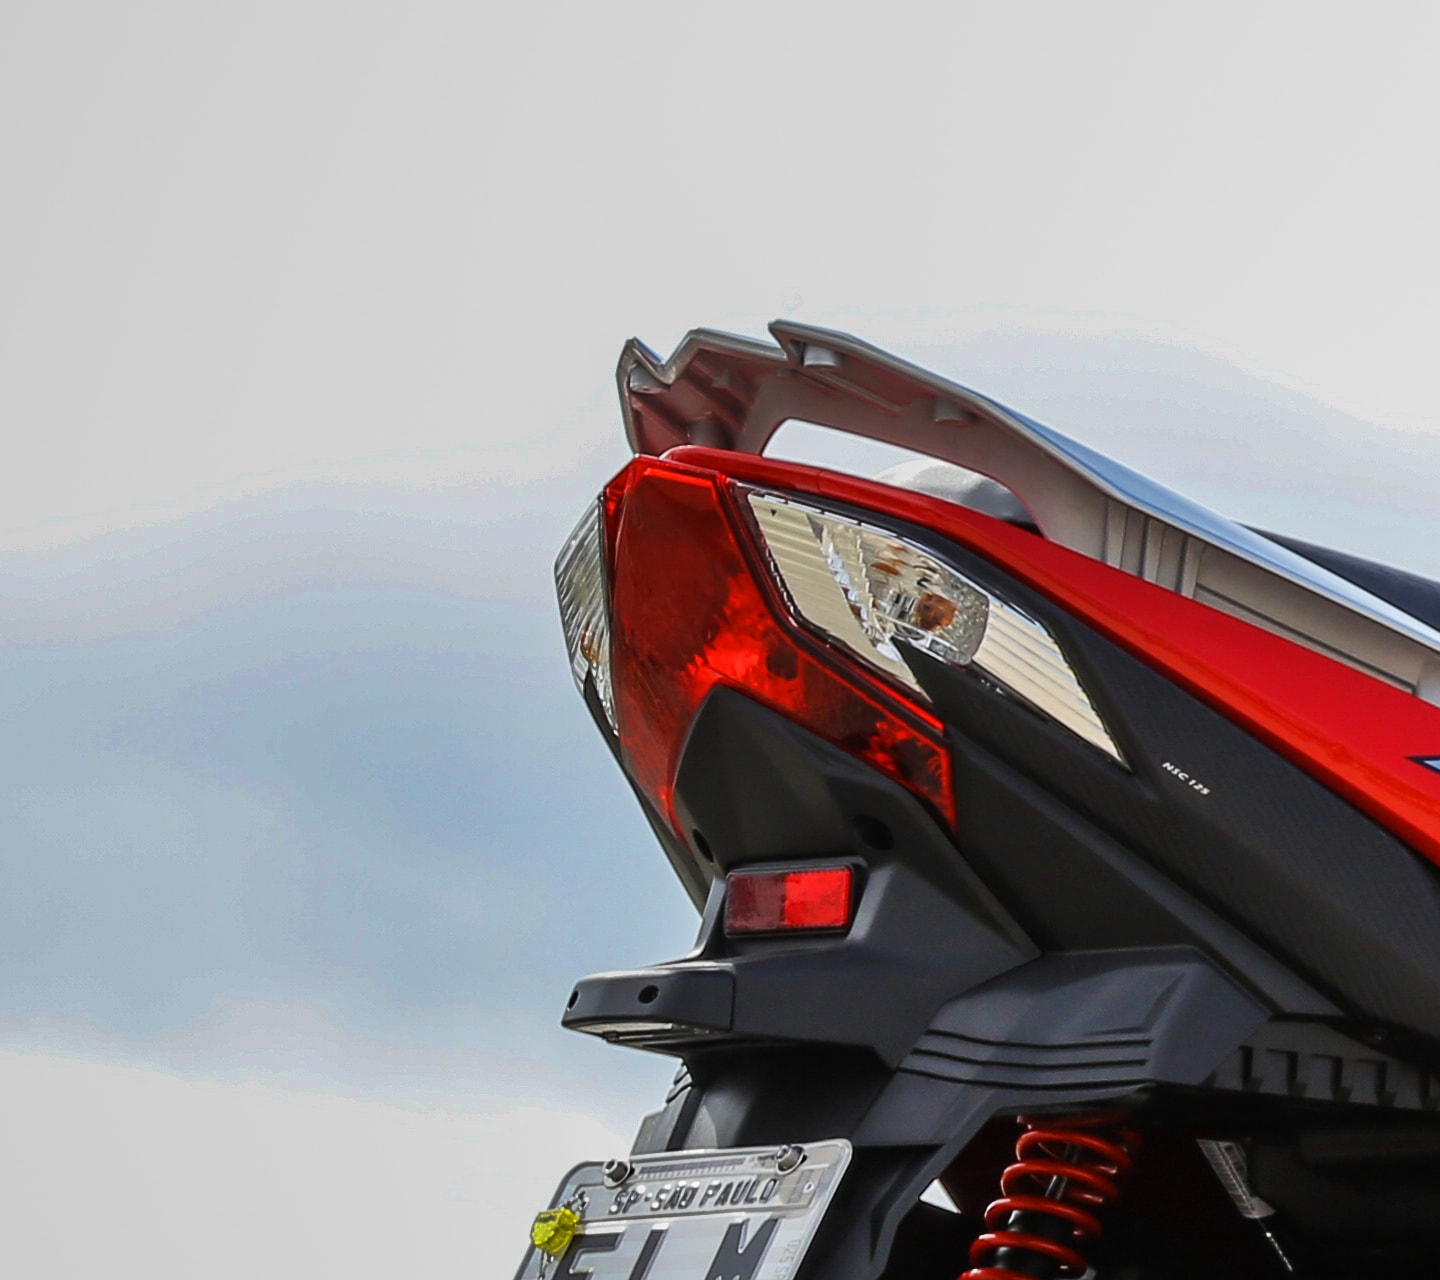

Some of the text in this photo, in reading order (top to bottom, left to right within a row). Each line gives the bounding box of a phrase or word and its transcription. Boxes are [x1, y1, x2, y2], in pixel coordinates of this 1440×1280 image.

[1162, 761, 1211, 795] NSC 125
[698, 1177, 780, 1208] PAULO
